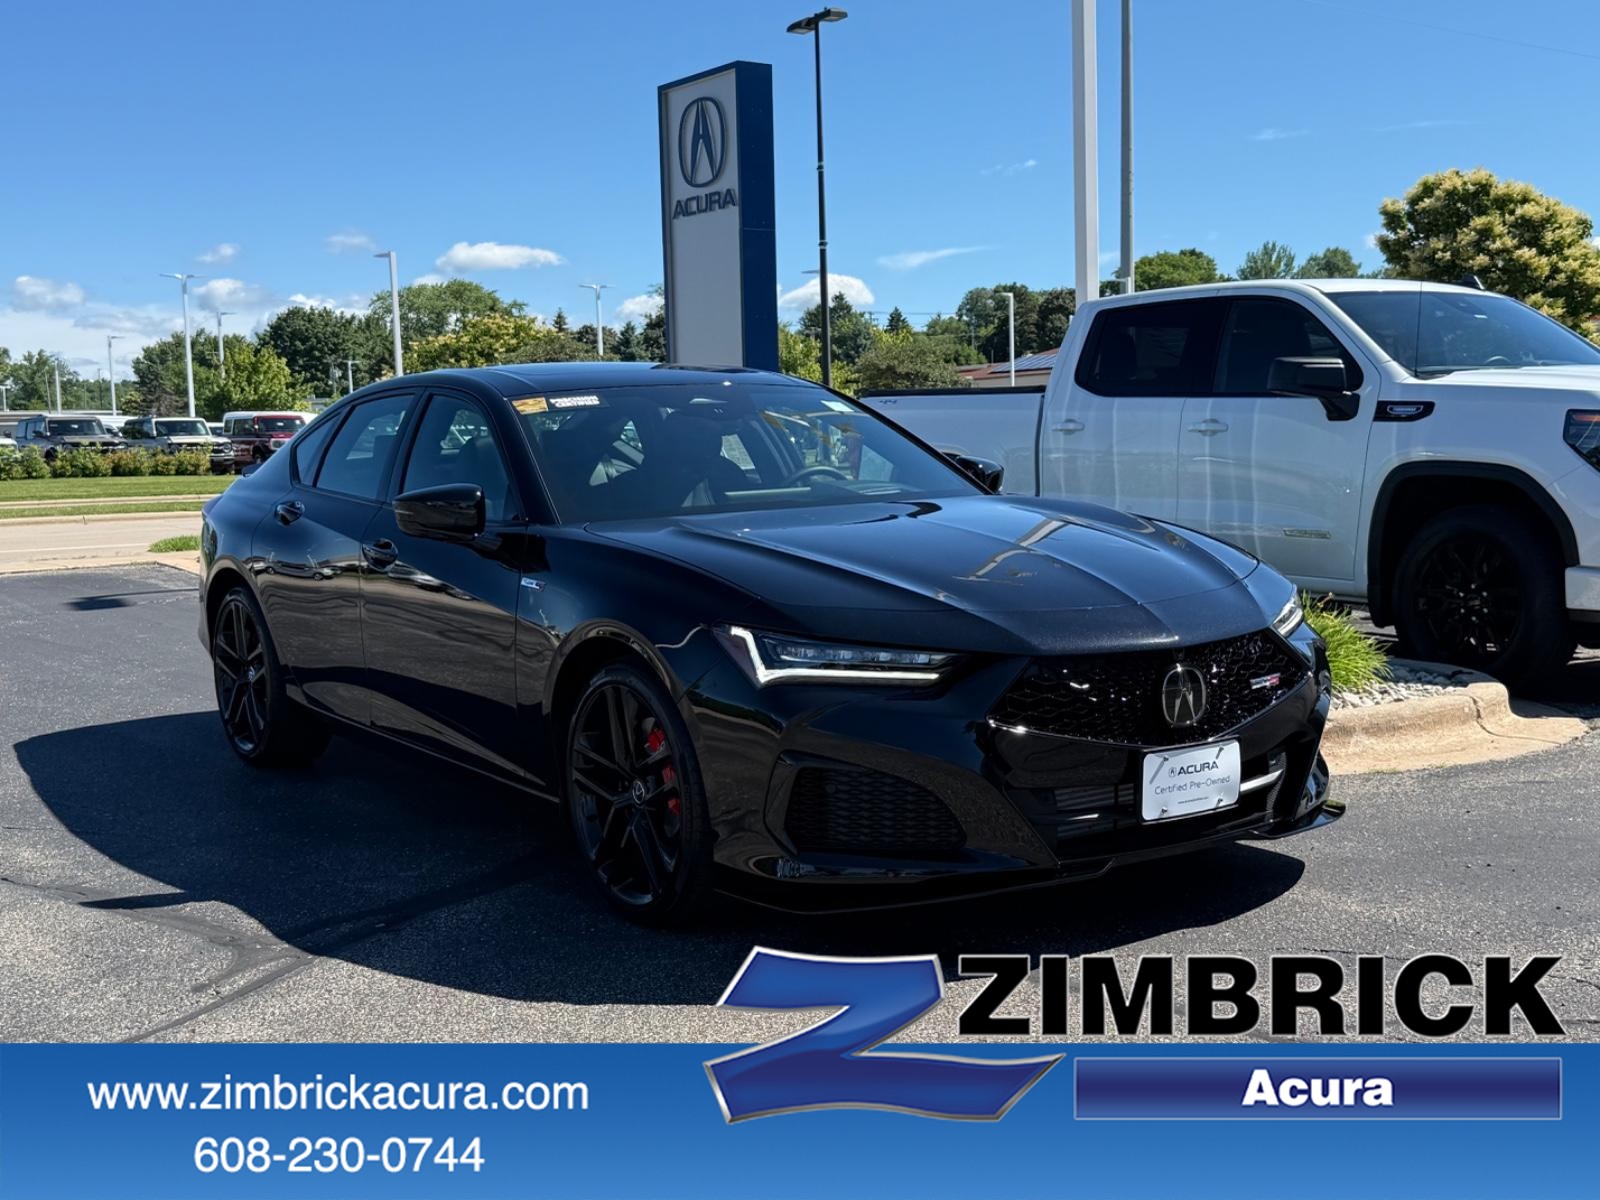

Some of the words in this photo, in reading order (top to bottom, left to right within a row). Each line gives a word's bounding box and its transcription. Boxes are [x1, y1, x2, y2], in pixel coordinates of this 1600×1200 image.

[672, 188, 736, 219] ACURA
[1178, 761, 1218, 776] ACURA
[1155, 783, 1187, 795] Certified
